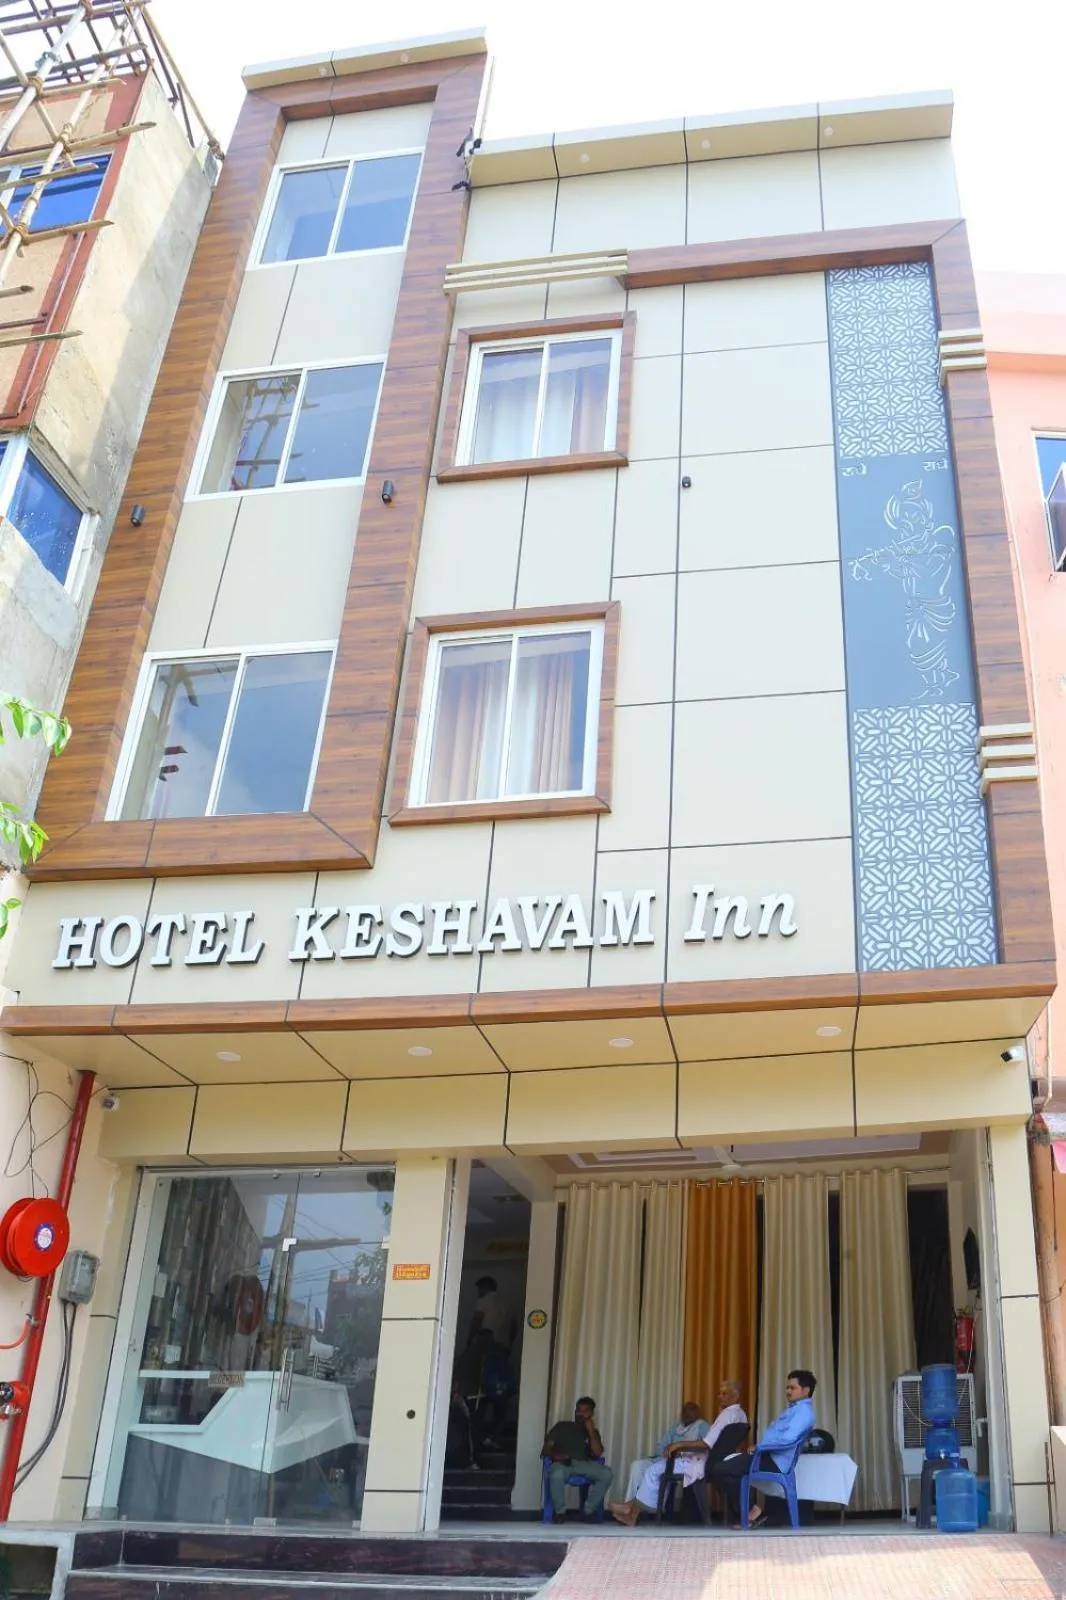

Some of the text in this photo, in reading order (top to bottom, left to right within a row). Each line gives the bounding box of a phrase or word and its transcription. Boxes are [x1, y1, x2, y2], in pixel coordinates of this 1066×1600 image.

[51, 883, 798, 970] HOTEL KESHAVAM Inn
